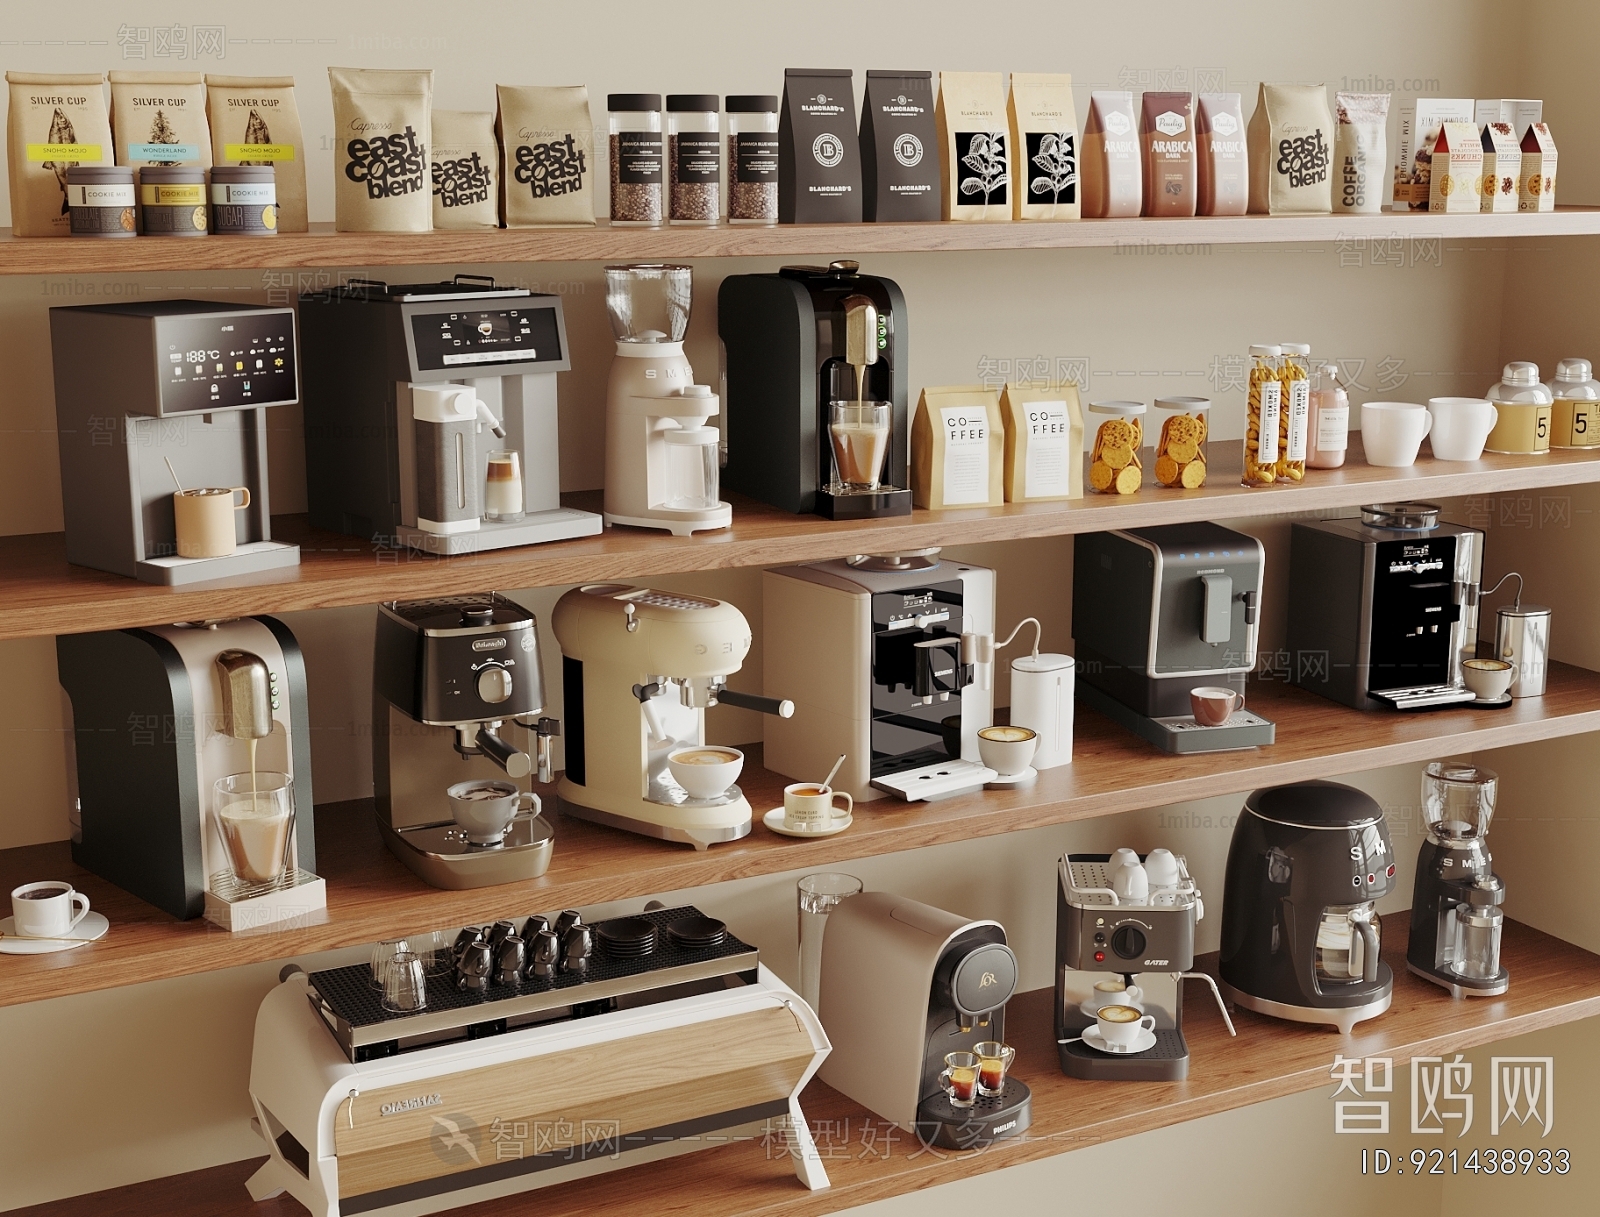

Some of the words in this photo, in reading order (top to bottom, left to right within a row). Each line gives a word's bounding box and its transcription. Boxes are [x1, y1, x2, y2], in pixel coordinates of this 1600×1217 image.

[31, 96, 64, 105] SILVER
[67, 96, 87, 105] CUP
[132, 97, 164, 106] SILVER
[167, 98, 187, 106] CUP
[227, 98, 259, 107] SILVER
[261, 99, 280, 107] CUP
[348, 118, 392, 134] Capresso
[518, 127, 555, 140] Capresso
[1158, 118, 1183, 130] Paulig
[347, 125, 419, 161] east
[515, 133, 578, 165] east
[1104, 140, 1140, 153] ARABICA
[1151, 140, 1194, 153] ARABICA
[1210, 140, 1246, 153] ARABICA
[1279, 129, 1323, 157] east
[345, 144, 427, 182] coast
[432, 152, 483, 178] east
[514, 150, 587, 183] coast
[1277, 143, 1329, 175] coast
[1289, 164, 1326, 188] blend
[1356, 134, 1366, 207] ORGANIC
[367, 169, 424, 199] blend
[530, 174, 582, 199] blend
[441, 185, 488, 208] blend
[217, 206, 244, 226] SUGAR
[947, 417, 967, 427] CO
[1029, 411, 1049, 421] CO
[1575, 413, 1587, 434] 5
[950, 429, 984, 440] FFEE
[1032, 423, 1065, 434] FFEE
[1537, 417, 1547, 438] 5
[993, 1120, 1017, 1135] PHILIPS
